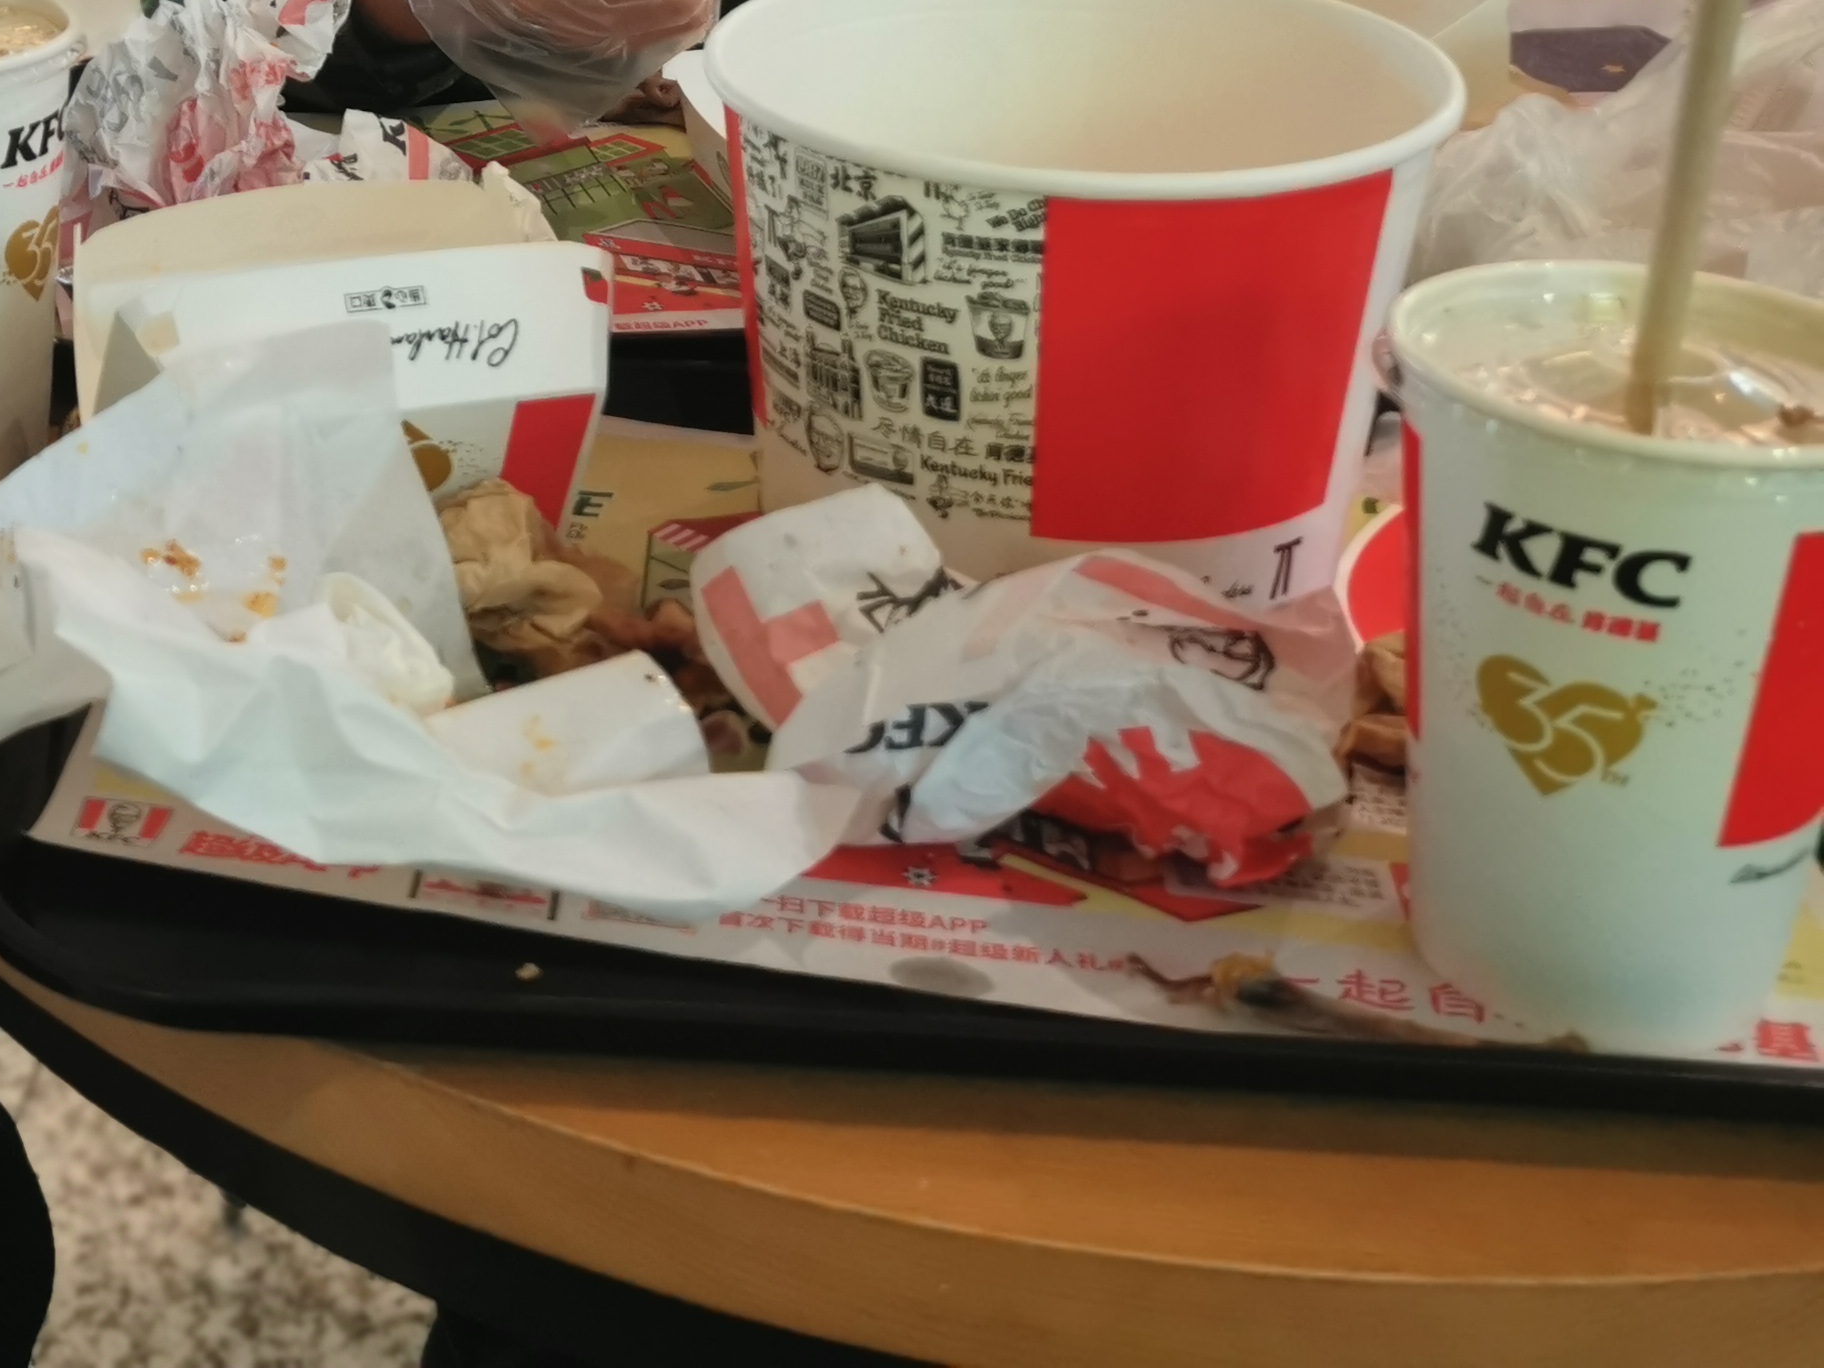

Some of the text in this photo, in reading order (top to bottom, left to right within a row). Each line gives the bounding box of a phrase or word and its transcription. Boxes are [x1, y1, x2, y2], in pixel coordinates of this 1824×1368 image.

[875, 288, 960, 324] Kentucky
[878, 306, 924, 332] Fried
[878, 323, 950, 355] Chicken
[919, 452, 998, 487] Kentucky
[1471, 500, 1693, 609] KFC
